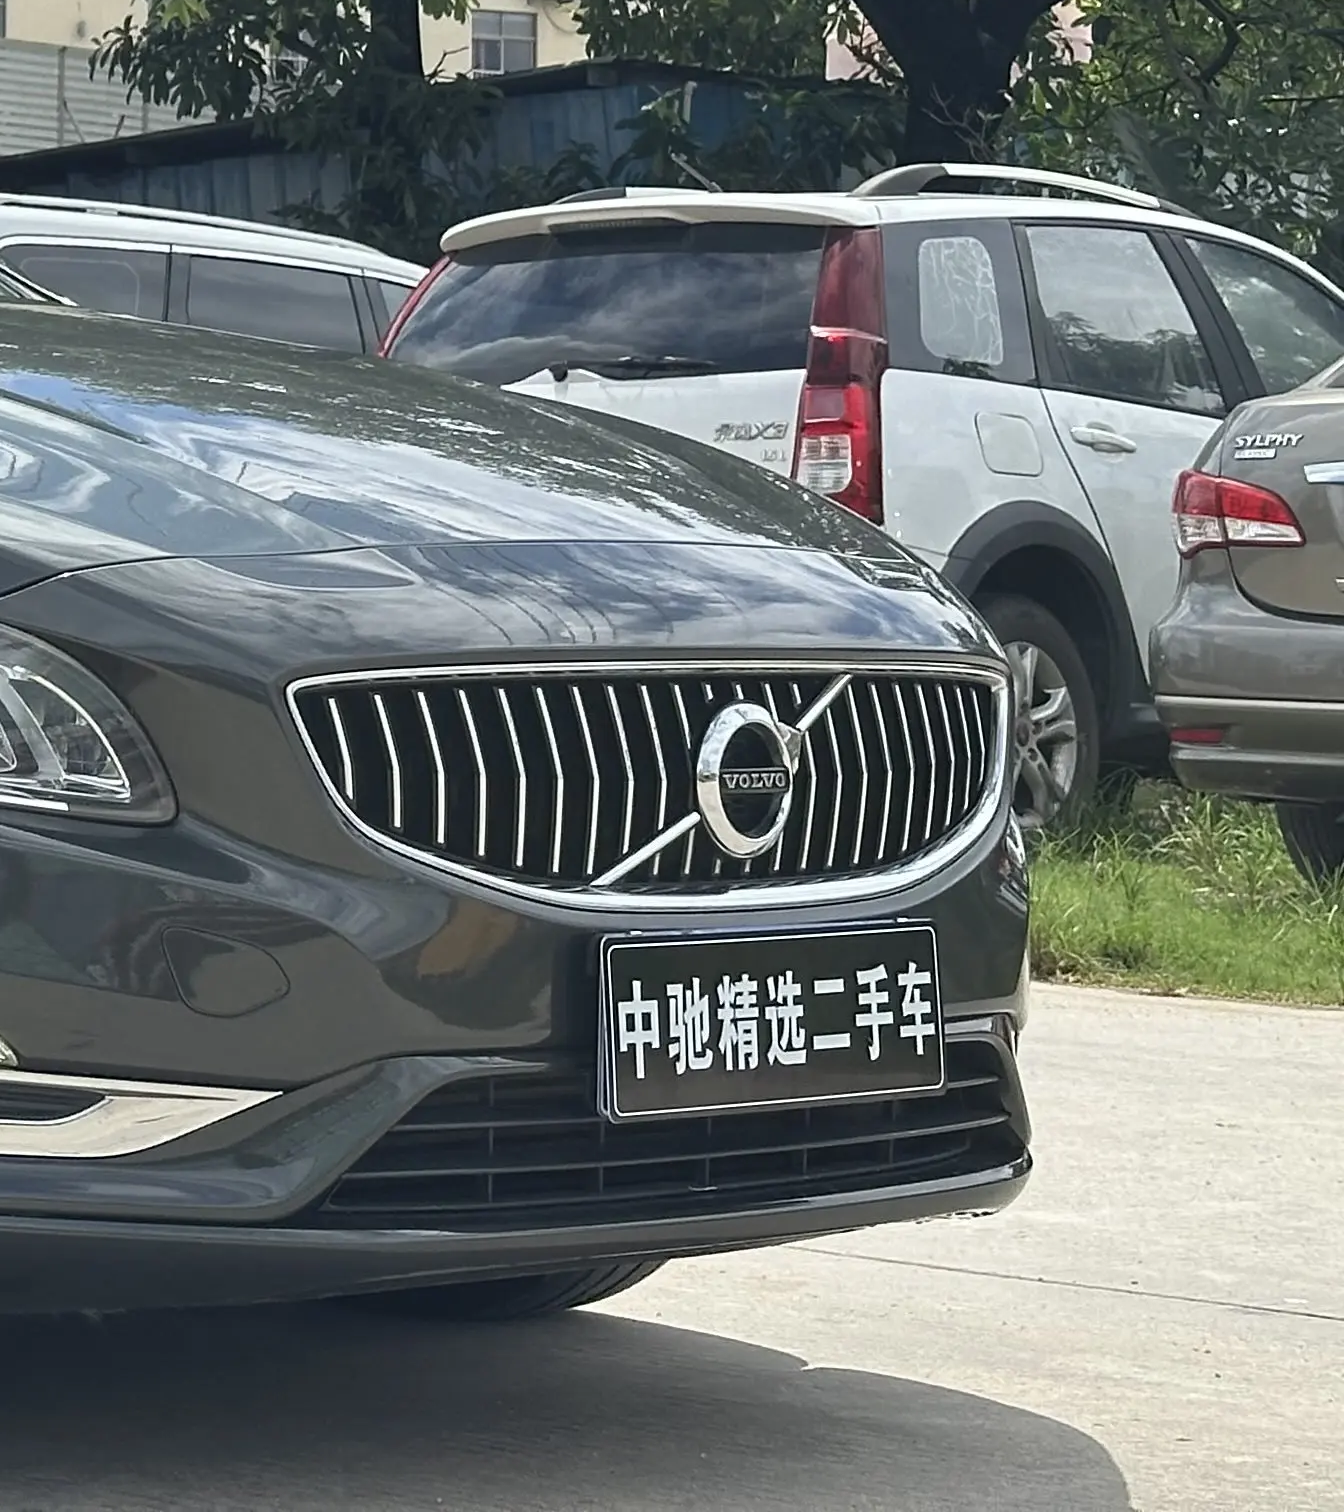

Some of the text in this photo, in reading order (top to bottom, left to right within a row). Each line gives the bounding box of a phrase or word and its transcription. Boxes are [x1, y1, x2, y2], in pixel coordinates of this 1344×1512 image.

[1234, 434, 1304, 447] SYLPHY
[722, 772, 786, 789] VOLVO
[618, 961, 936, 1079] 中驰精选二手车
